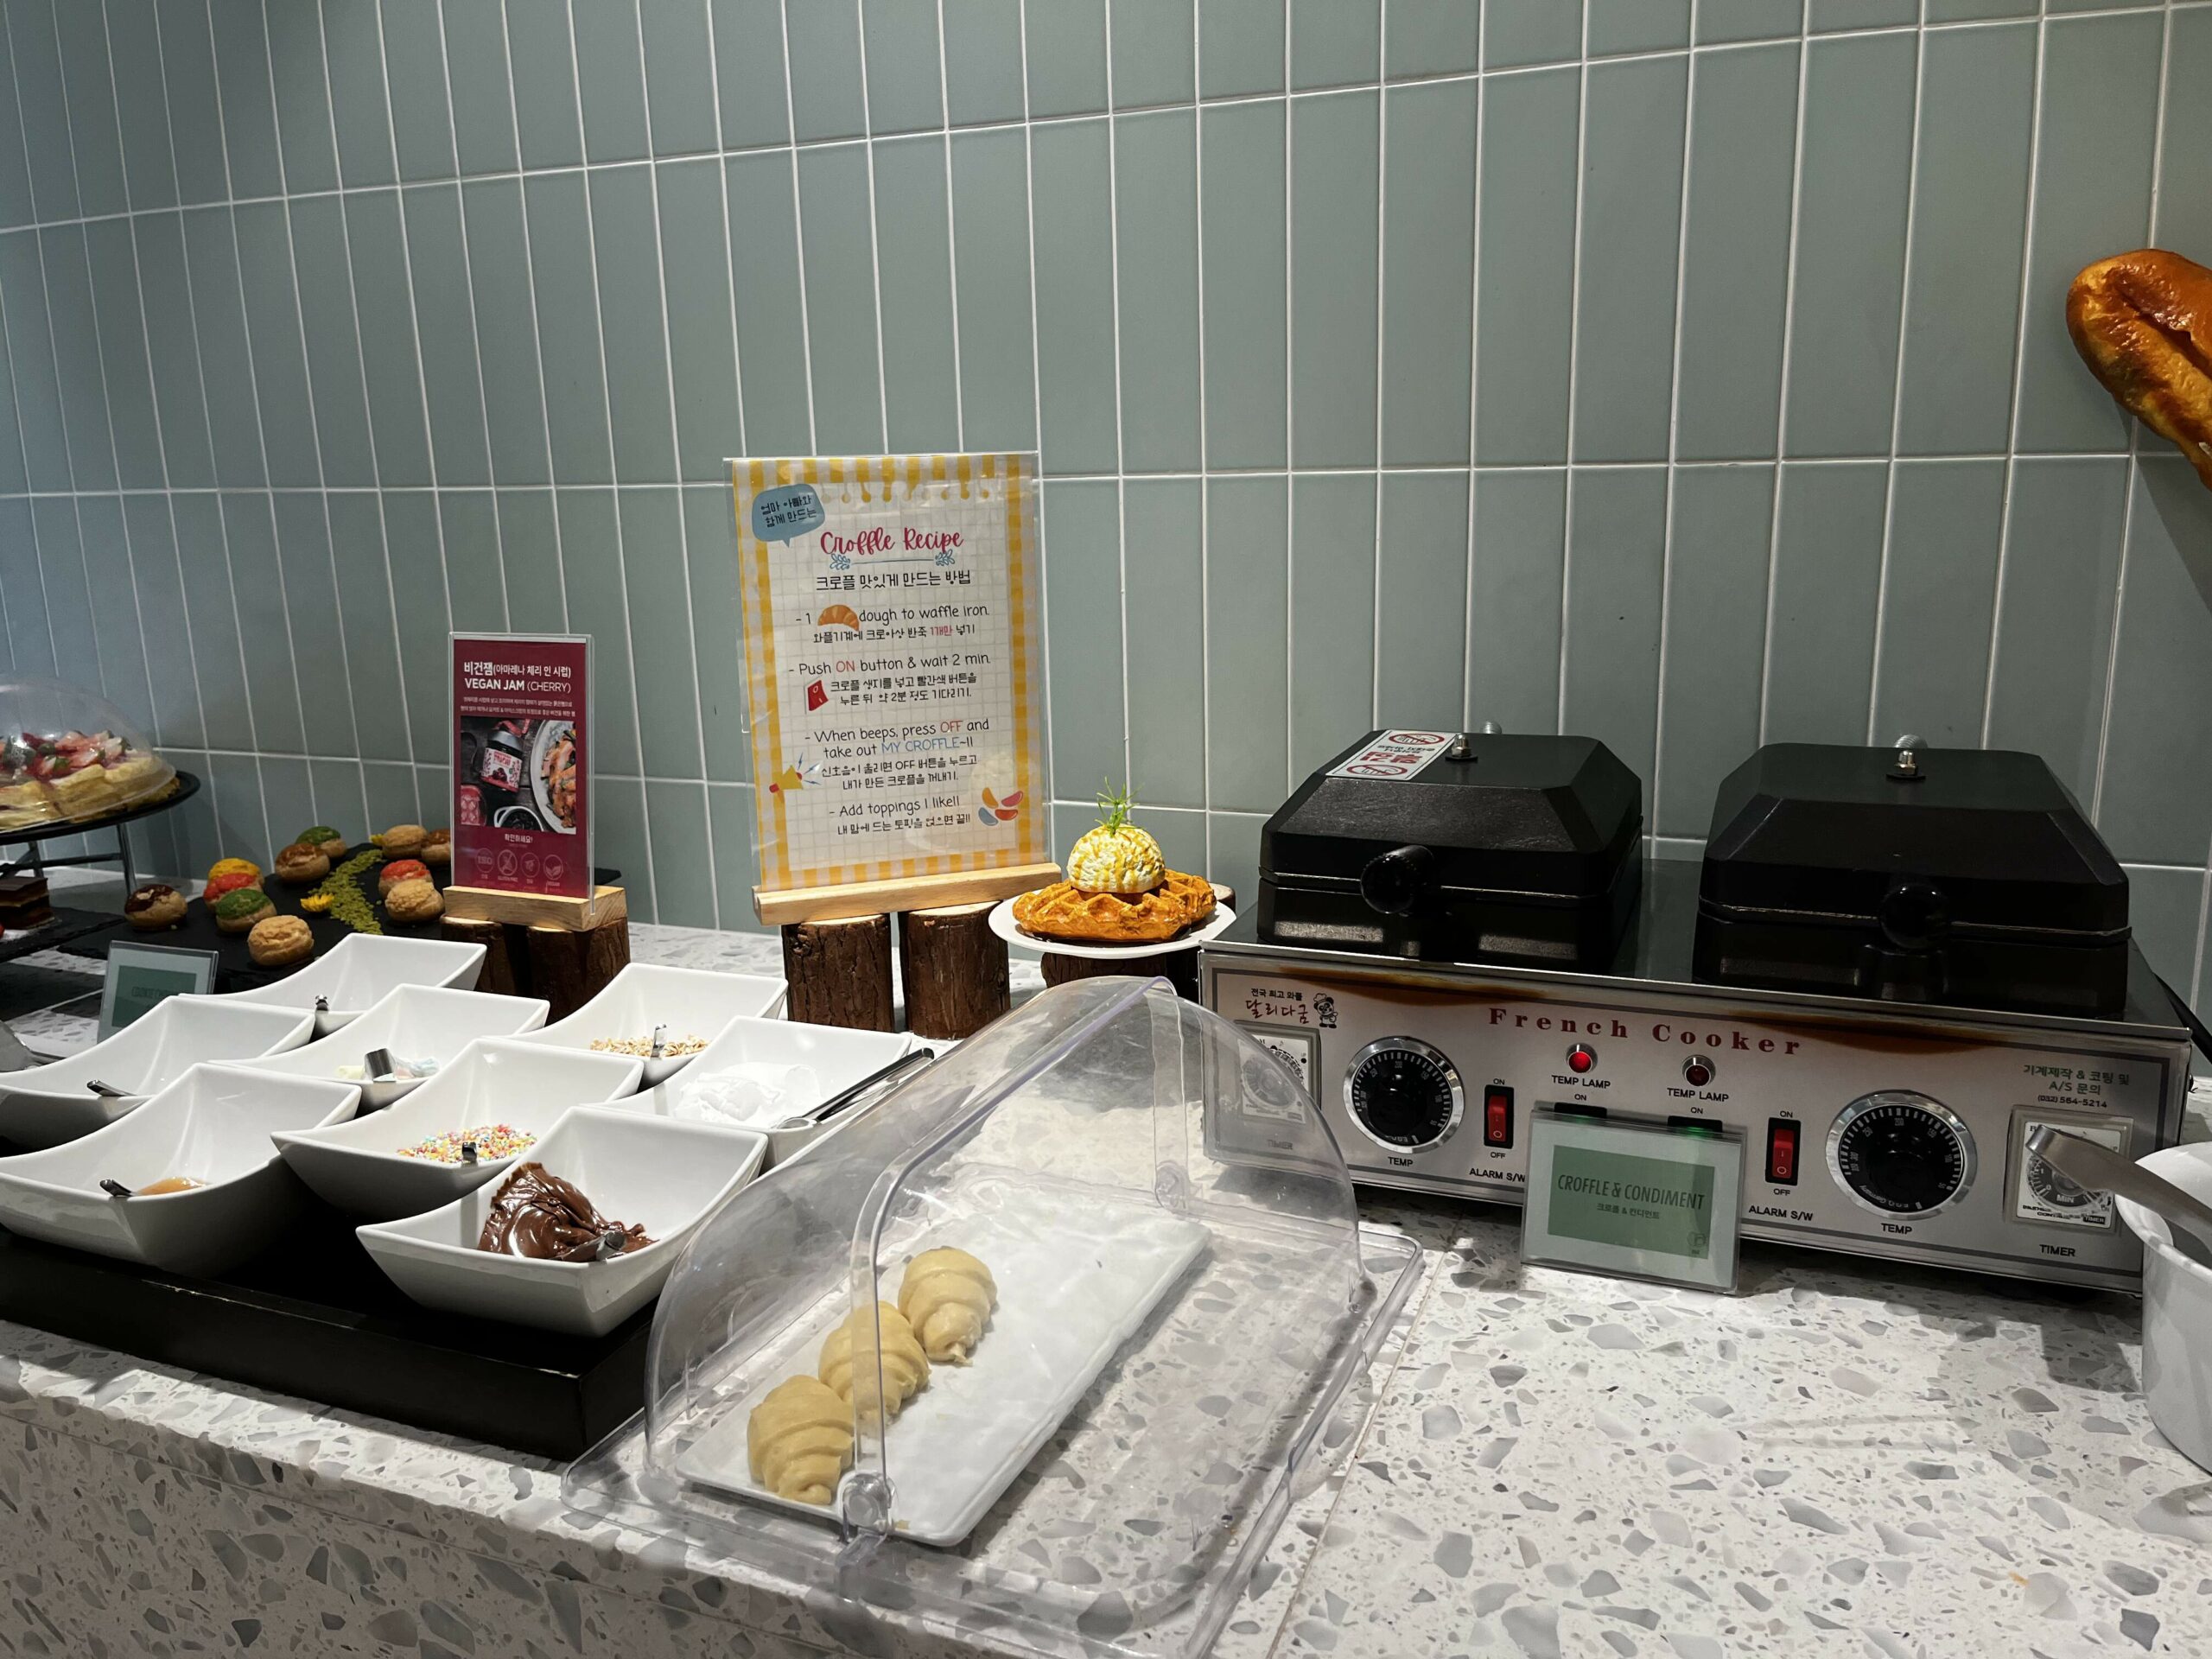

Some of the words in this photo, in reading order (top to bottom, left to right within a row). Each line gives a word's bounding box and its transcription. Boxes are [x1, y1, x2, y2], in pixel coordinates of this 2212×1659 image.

[760, 499, 780, 513] 엄마
[783, 495, 812, 508] 아빠와
[765, 513, 785, 528] 함께
[786, 508, 817, 523] 만드는
[820, 527, 895, 555] Croffle
[903, 527, 965, 554] Recipe
[816, 575, 855, 591] 크로플
[860, 574, 899, 588] 맛있게
[903, 571, 941, 588] 만드는
[945, 569, 970, 585] 방법
[859, 608, 897, 626] dough
[901, 607, 914, 620] to
[918, 606, 959, 619] waffle
[813, 631, 863, 644] 와플기계에
[866, 627, 906, 641] 크로아상
[907, 626, 927, 638] 반죽
[930, 625, 953, 637] 1개만
[956, 624, 976, 635] 넣기
[464, 661, 525, 677] 비건잼(아마레나
[526, 665, 542, 676] 체리
[543, 665, 551, 677] 인
[553, 665, 571, 678] 시럽)
[799, 663, 831, 676] Push
[836, 660, 855, 673] ON
[860, 658, 903, 672] button
[907, 657, 917, 668] &
[920, 656, 949, 668] wait
[952, 655, 961, 665] 2
[464, 677, 501, 690] VEGAN
[503, 679, 525, 691] JAM
[527, 681, 571, 694] (CHERRY)
[830, 679, 861, 692] 크로플
[862, 677, 893, 690] 생지를
[894, 676, 915, 689] 넣고
[917, 674, 946, 687] 빨간색
[949, 672, 977, 684] 버튼을
[840, 694, 860, 706] 누른
[863, 694, 873, 704] 뒤
[879, 693, 888, 703] 약
[891, 691, 907, 702] 2분
[909, 690, 929, 702] 정도
[931, 688, 972, 700] 기다리기.
[814, 730, 856, 743] When
[902, 724, 937, 742] press
[940, 720, 963, 734] OFF
[967, 718, 989, 731] and
[823, 746, 852, 760] take
[856, 744, 877, 756] out
[881, 741, 900, 754] MY
[822, 766, 861, 779] 신호음이
[863, 761, 893, 774] 울리면
[895, 760, 915, 771] OFF
[918, 757, 946, 769] 버튼을
[949, 754, 977, 766] 누르고
[842, 779, 861, 791] 내가
[865, 777, 884, 788] 만든
[887, 773, 925, 786] 크로플을
[927, 771, 959, 783] 꺼내기.
[839, 804, 863, 817] Add
[868, 800, 921, 817] toppings
[837, 824, 848, 836] 내
[850, 823, 869, 835] 맘에
[872, 821, 893, 832] 드는
[894, 818, 924, 830] 토핑을
[925, 815, 954, 828] 얹으면
[1251, 988, 1266, 998] 전국
[1488, 1007, 1629, 1039] French
[1651, 1023, 1801, 1056] Cooker
[1551, 1074, 1579, 1087] TEMP
[1581, 1077, 1611, 1090] LAMP
[2023, 1065, 2073, 1080] 기계제작
[2076, 1070, 2085, 1079] &
[2088, 1071, 2114, 1084] 코팅
[2118, 1073, 2130, 1086] 및
[1667, 1087, 1696, 1100] TEMP
[1699, 1090, 1729, 1103] LAMP
[2049, 1081, 2073, 1092] A/S
[2076, 1083, 2101, 1096] 문의
[1574, 1093, 1587, 1102] ON
[1690, 1106, 1704, 1115] ON
[1266, 1138, 1294, 1150] TIMER
[1388, 1156, 1414, 1167] TEMP
[1490, 1151, 1506, 1160] OFF
[1469, 1167, 1503, 1180] ALARM
[1506, 1172, 1526, 1184] S/W
[1557, 1173, 1610, 1197] CROFFLE
[1611, 1182, 1621, 1198] &
[1624, 1184, 1706, 1211] CONDIMENT
[1596, 1203, 1620, 1214] 크로플
[1622, 1206, 1628, 1215] &
[1629, 1207, 1660, 1220] 컨디먼트
[1748, 1205, 1787, 1218] ALARM
[1790, 1211, 1814, 1221] S/W
[1880, 1223, 1913, 1235] TEMP
[2038, 1243, 2076, 1257] TIMER
